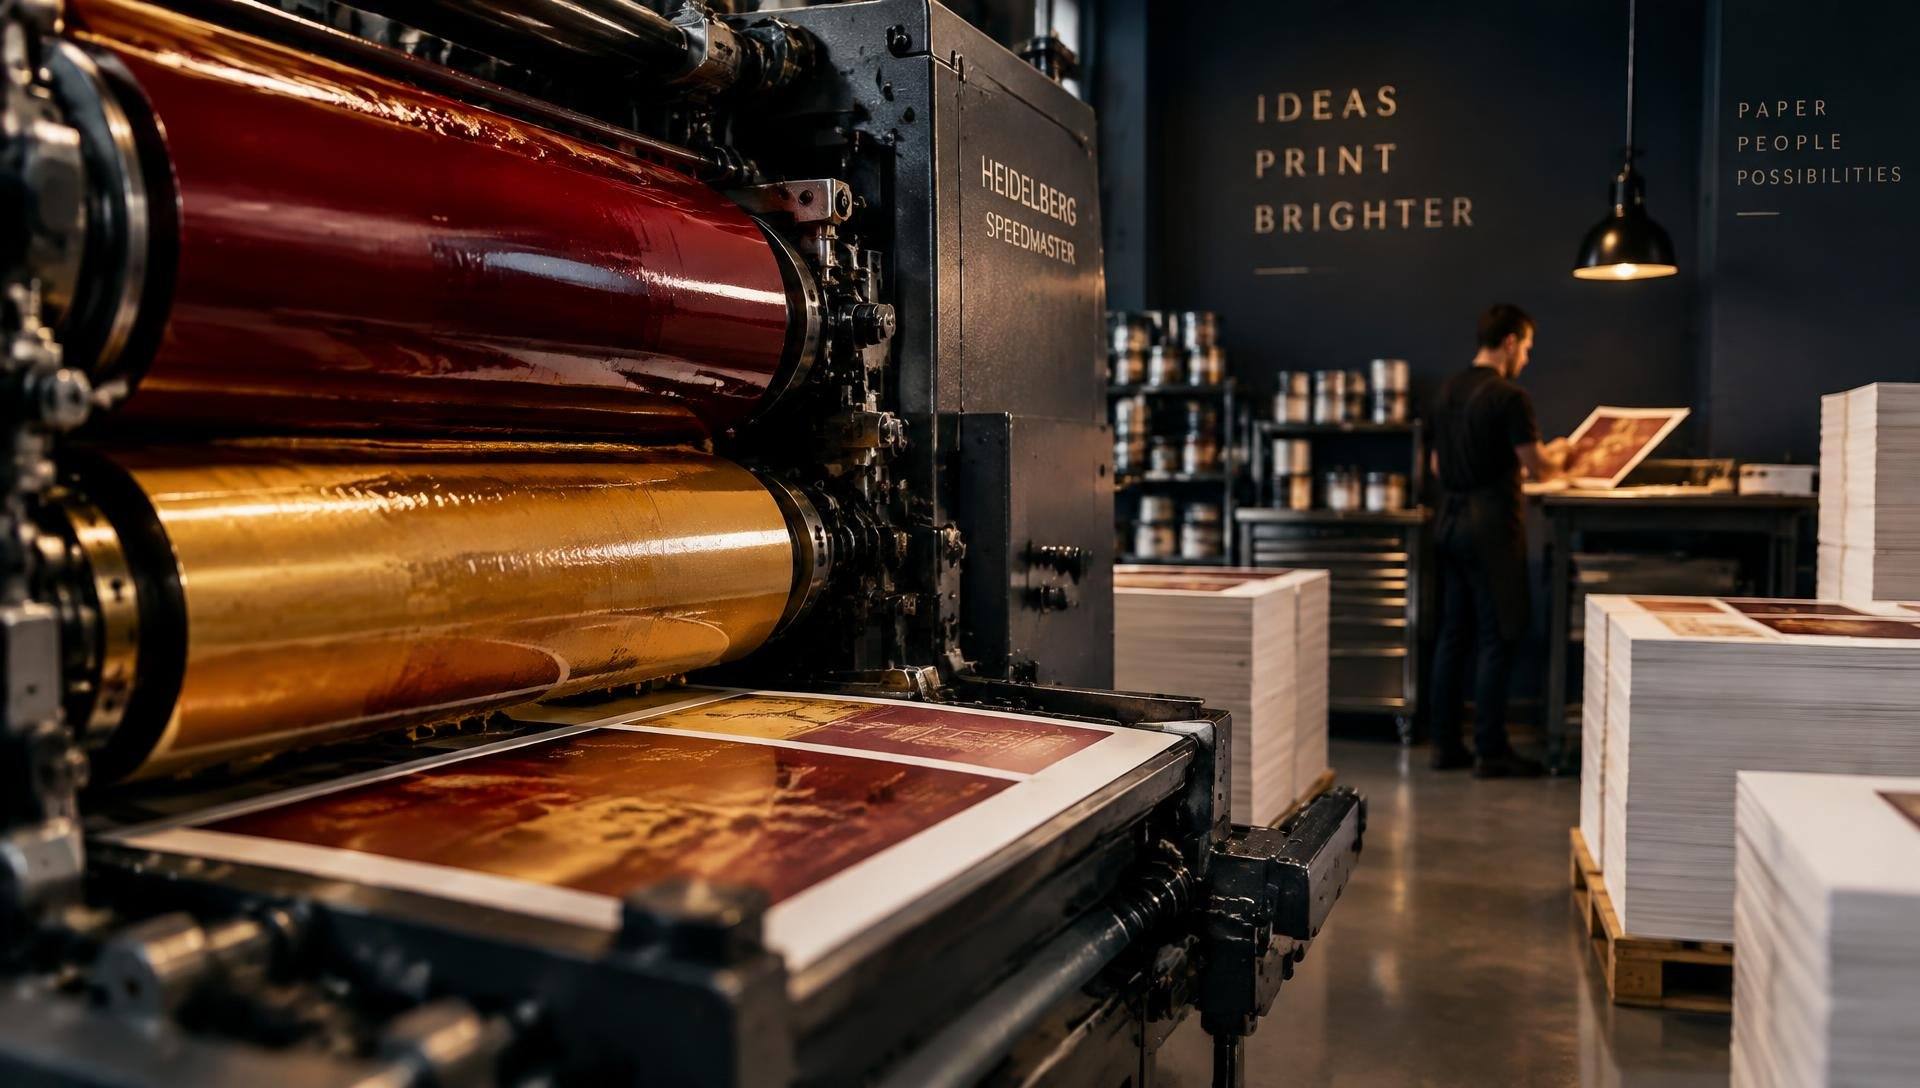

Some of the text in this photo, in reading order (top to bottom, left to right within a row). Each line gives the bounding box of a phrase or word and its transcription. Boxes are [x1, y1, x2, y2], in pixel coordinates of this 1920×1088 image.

[1257, 85, 1397, 123] IDEAS
[1738, 99, 1826, 119] PAPER
[1738, 133, 1841, 152] PEOPLE
[1255, 143, 1397, 179] PRINT
[1737, 166, 1901, 186] POSSIBILITIES
[982, 155, 1077, 226] HEIDELBERG
[1254, 197, 1474, 234] BRIGHTER
[986, 211, 1076, 265] SPEEDMASTER
